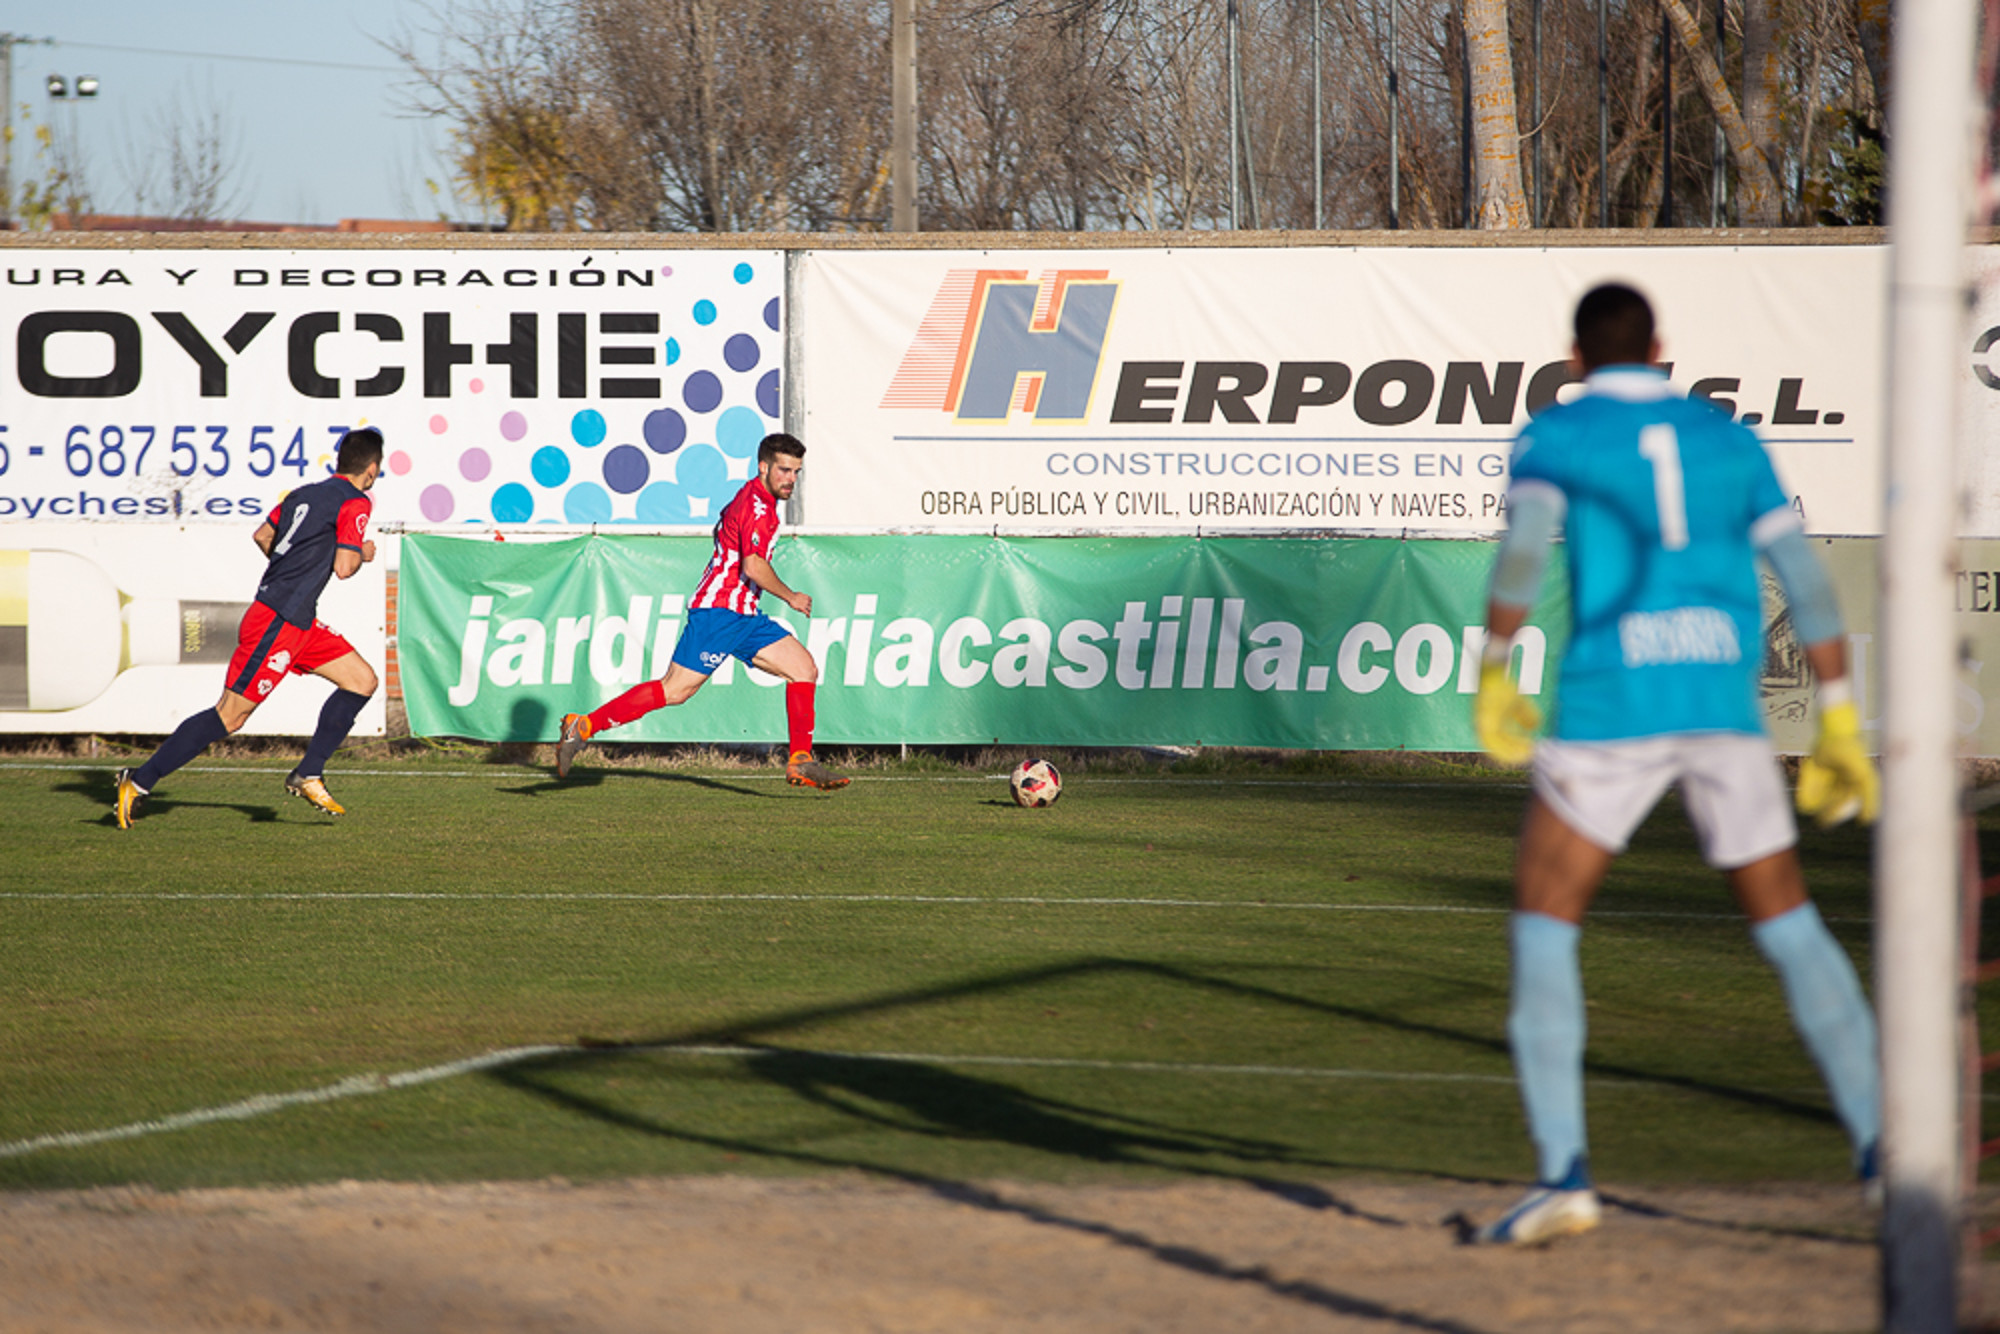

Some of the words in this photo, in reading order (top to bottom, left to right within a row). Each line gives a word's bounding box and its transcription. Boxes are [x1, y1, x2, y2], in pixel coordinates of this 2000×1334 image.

[165, 268, 199, 286] Y
[234, 257, 655, 287] DECORACIÓN
[16, 310, 662, 399] OYCHE
[65, 425, 156, 477] 687
[170, 425, 230, 477] 53
[248, 425, 309, 477] 54
[325, 425, 385, 478] 3
[1046, 452, 1401, 478] CONSTRUCCIONES
[1414, 453, 1463, 477] EN
[921, 490, 983, 516] OBRA
[991, 485, 1087, 516] PÚBLICA
[1093, 490, 1108, 516] Y
[1115, 490, 1180, 519] CIVIL,
[1189, 486, 1361, 518] URBANIZACIÓN
[1368, 493, 1384, 517] Y
[1391, 493, 1474, 520] NAVES,
[1638, 421, 1691, 551] 1
